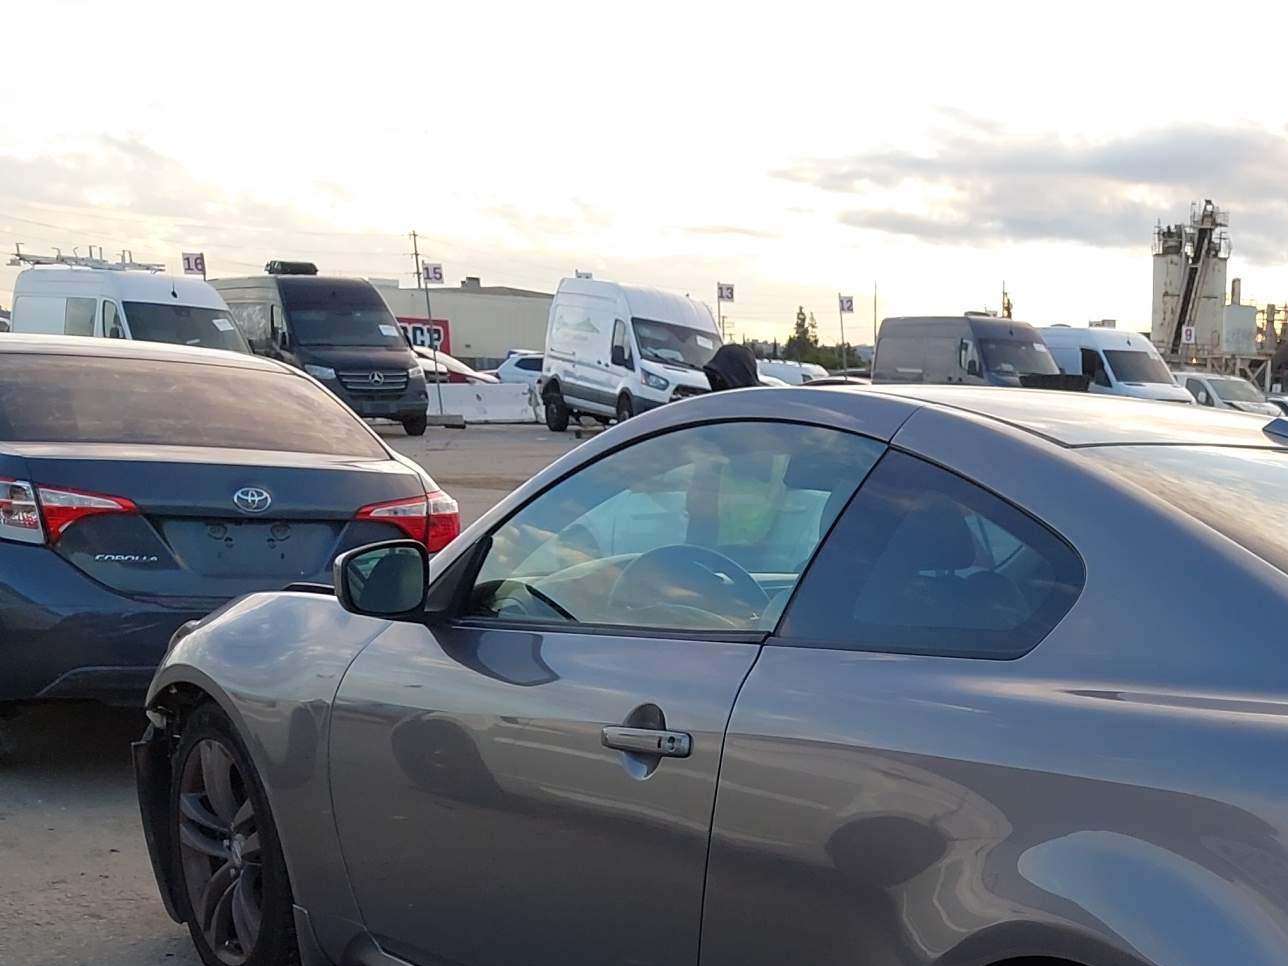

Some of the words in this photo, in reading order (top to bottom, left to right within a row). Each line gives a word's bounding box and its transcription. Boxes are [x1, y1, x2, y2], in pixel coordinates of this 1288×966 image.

[184, 257, 205, 271] 16
[423, 266, 443, 281] 15
[718, 287, 734, 299] 13
[840, 299, 853, 312] 12
